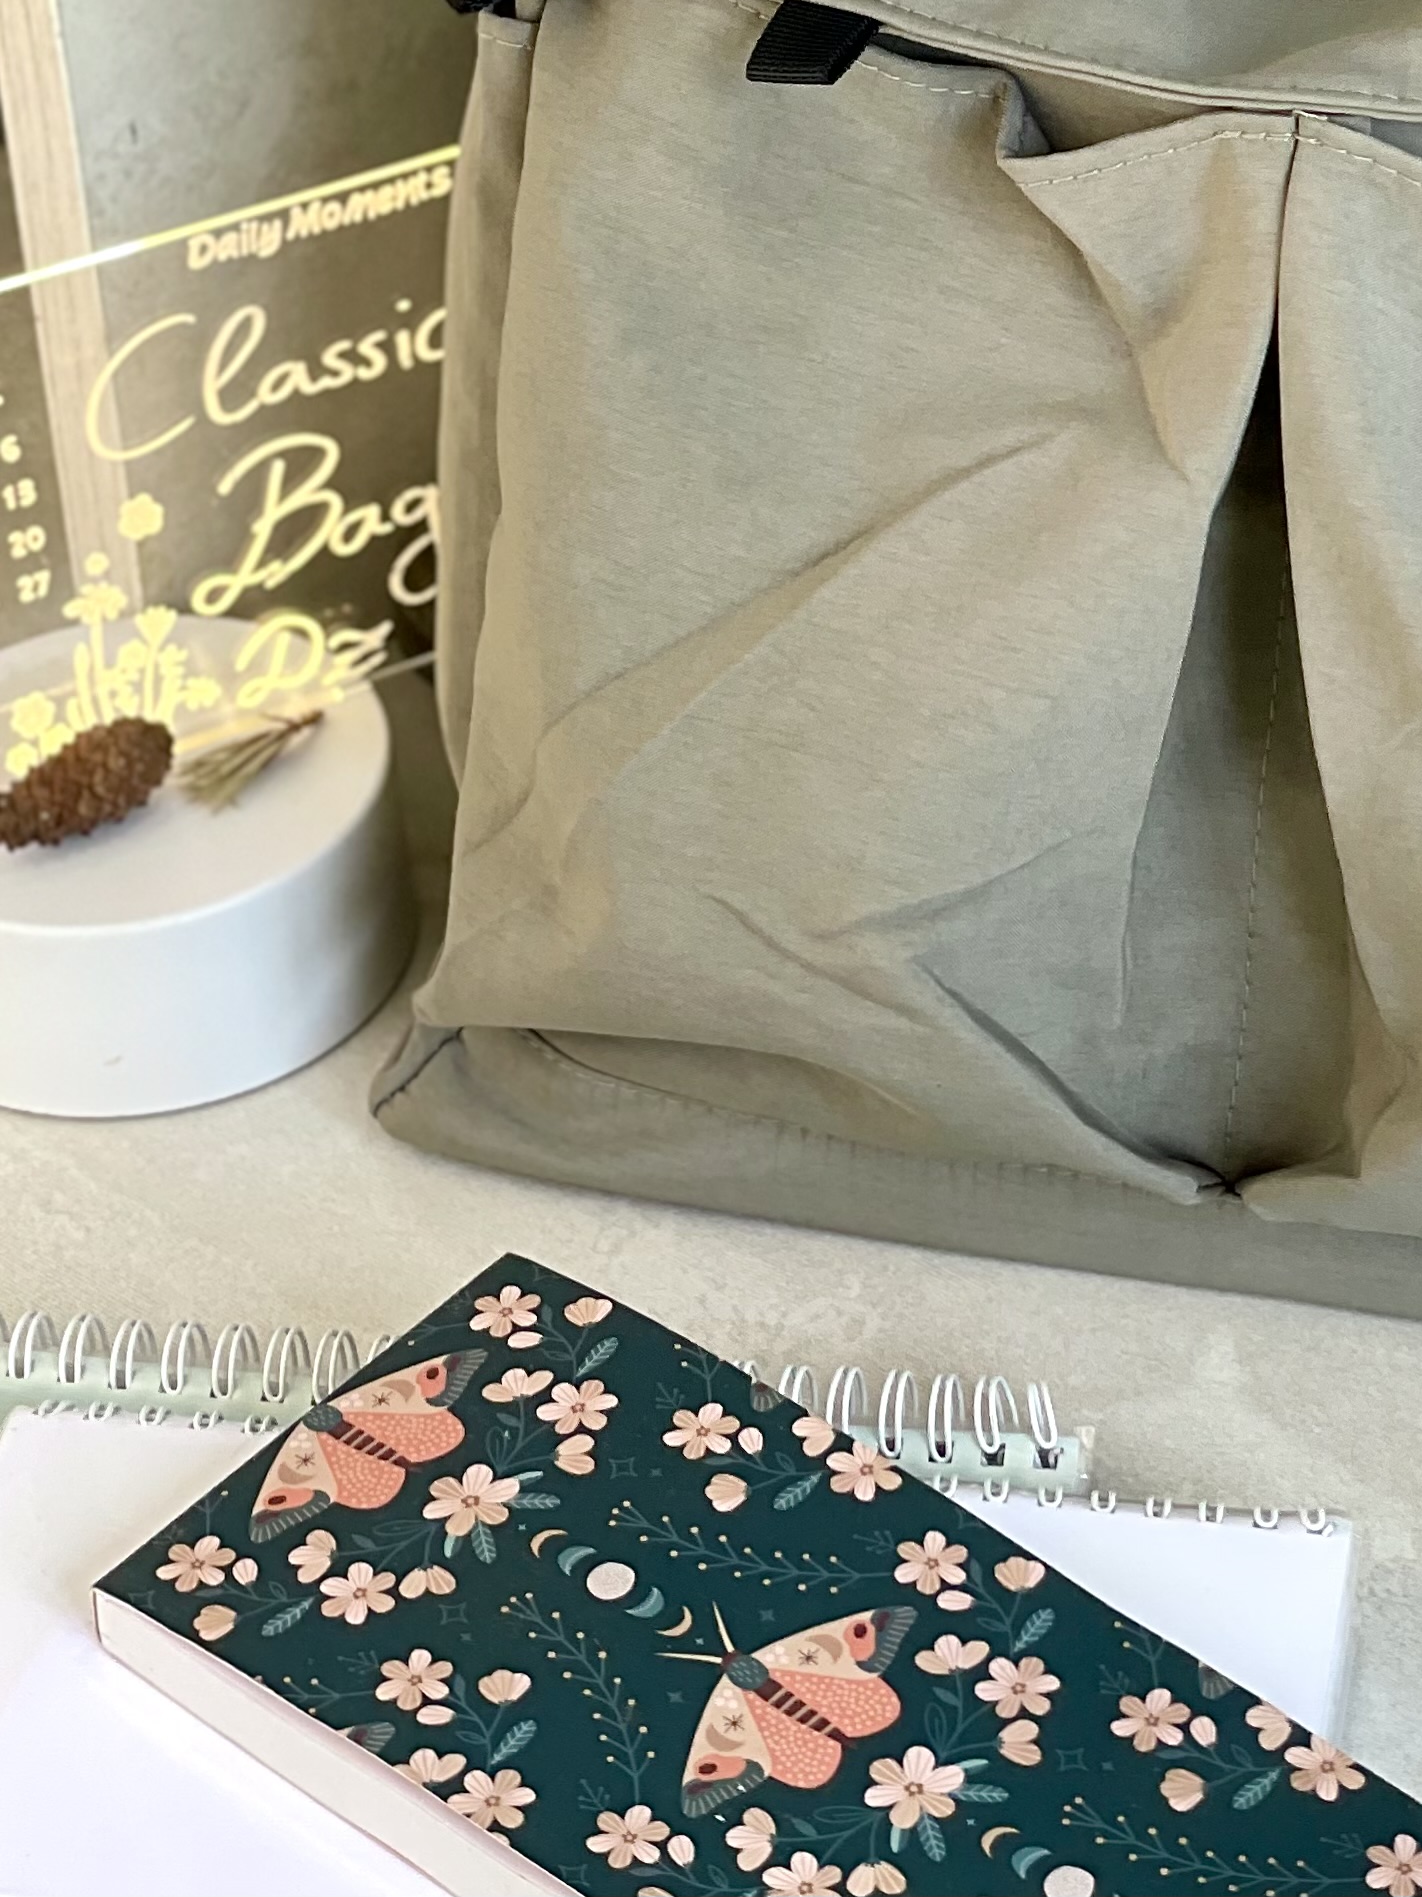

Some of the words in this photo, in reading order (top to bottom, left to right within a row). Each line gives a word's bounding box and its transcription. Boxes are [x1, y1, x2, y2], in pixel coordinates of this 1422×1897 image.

[187, 217, 282, 270] Daily
[286, 165, 453, 241] Moments
[86, 299, 447, 461] Classic
[2, 478, 37, 510] 13
[190, 432, 440, 616] Bag
[8, 525, 46, 559] 20
[16, 569, 51, 603] 27
